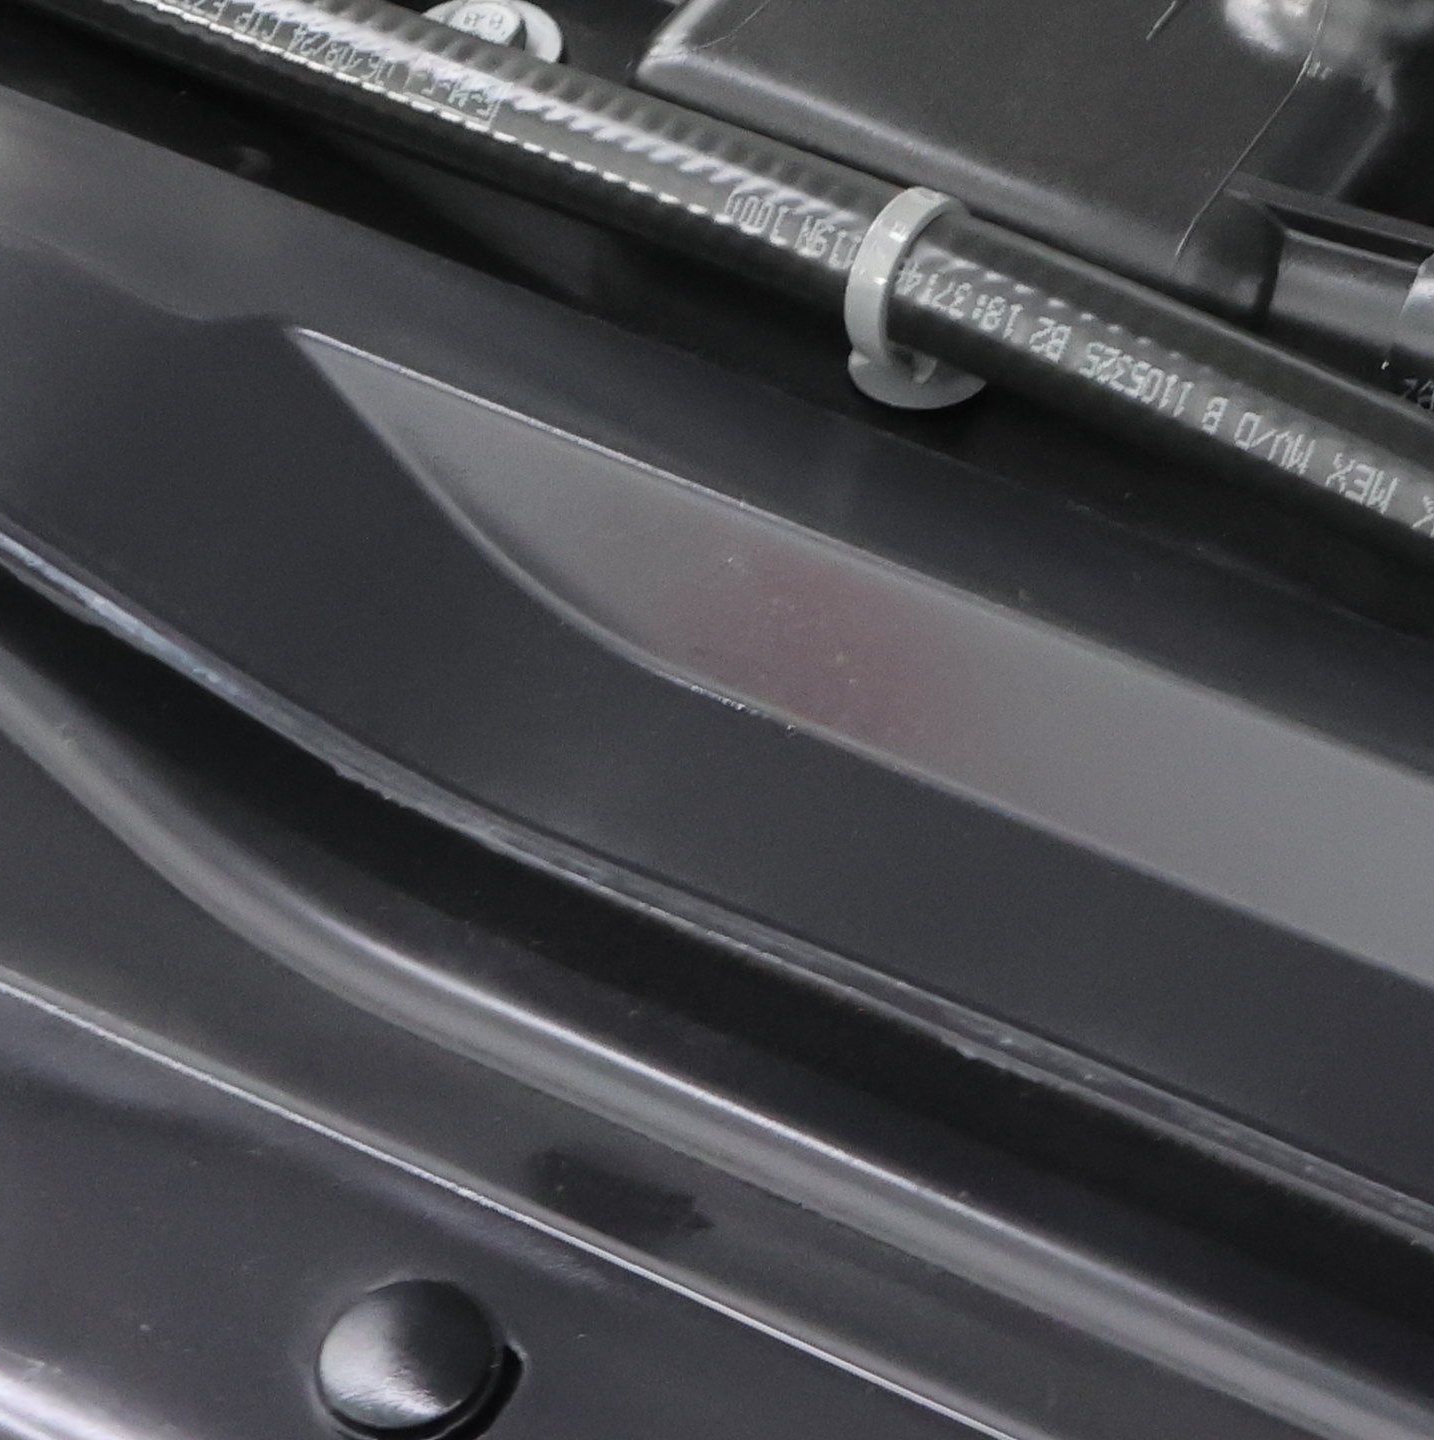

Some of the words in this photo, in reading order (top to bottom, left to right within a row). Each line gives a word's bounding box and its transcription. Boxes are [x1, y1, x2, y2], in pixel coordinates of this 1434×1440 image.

[897, 258, 1023, 341] 18:37:4
[1029, 316, 1072, 362] B2
[1202, 396, 1230, 434] B
[1325, 451, 1401, 516] MEX
